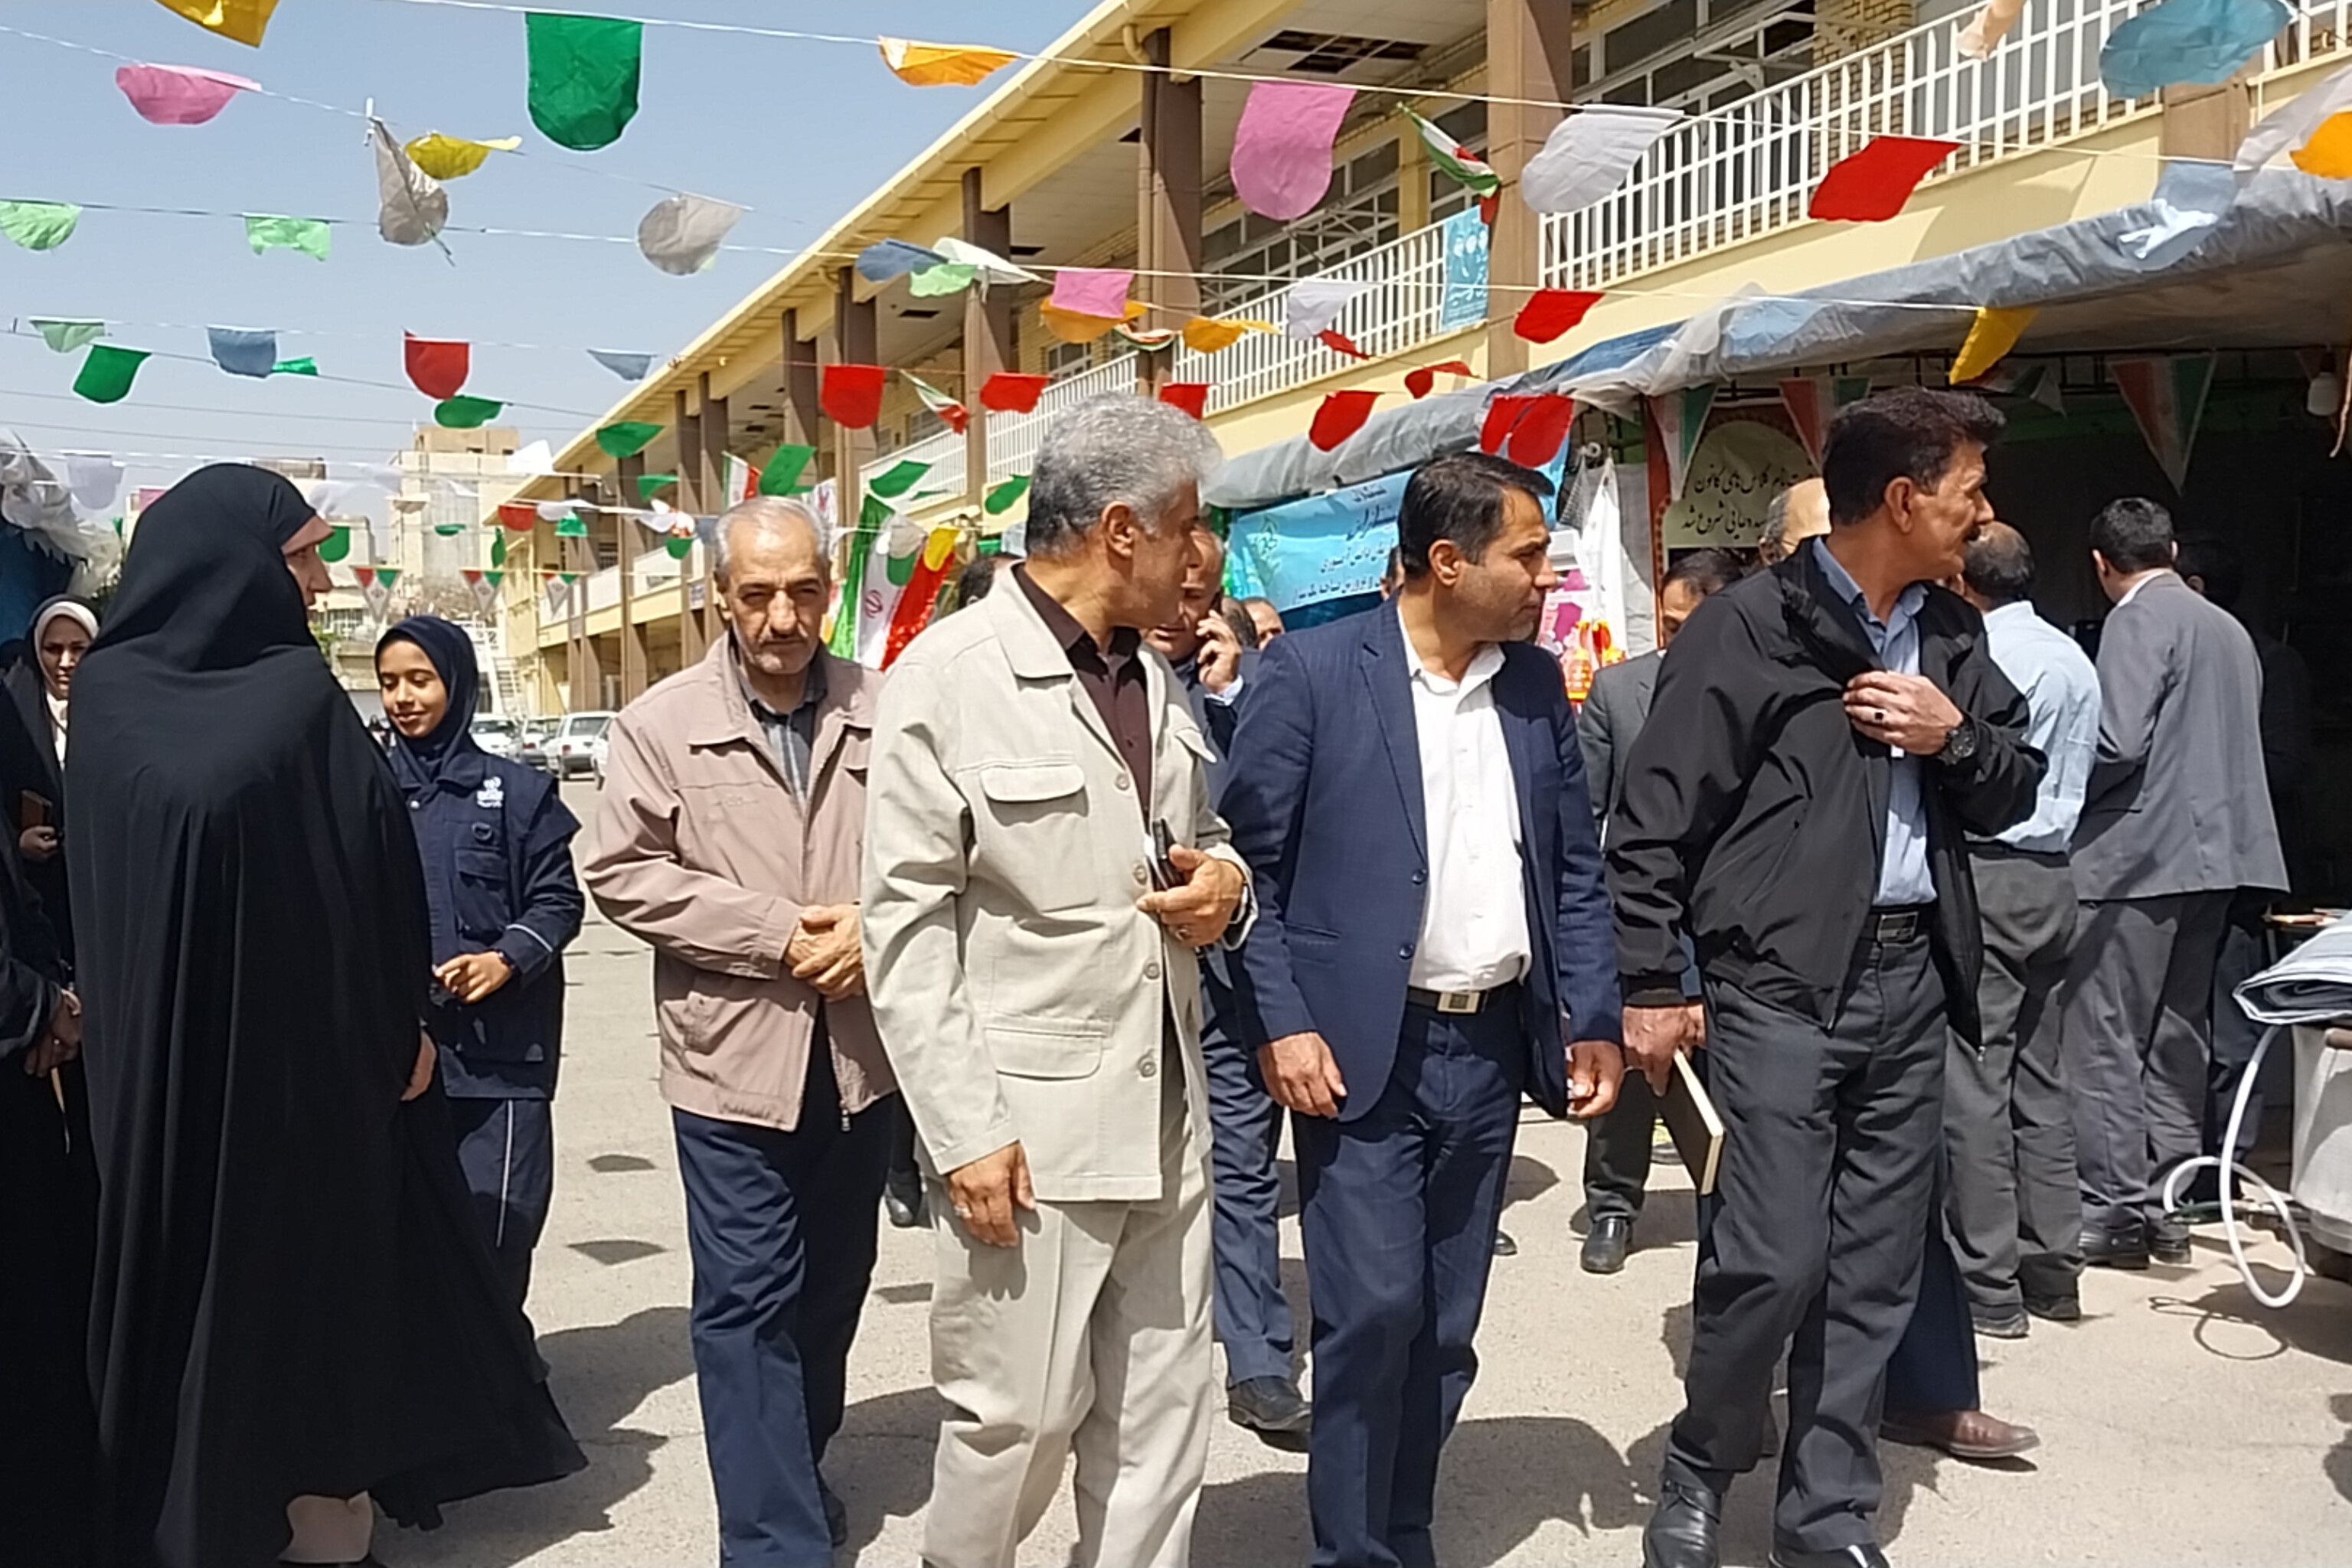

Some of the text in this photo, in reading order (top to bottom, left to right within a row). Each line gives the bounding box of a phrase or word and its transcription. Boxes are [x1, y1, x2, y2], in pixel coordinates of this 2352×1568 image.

[1694, 462, 1726, 494] کانون
[1681, 504, 1697, 530] شد
[1696, 500, 1724, 535] شروع
